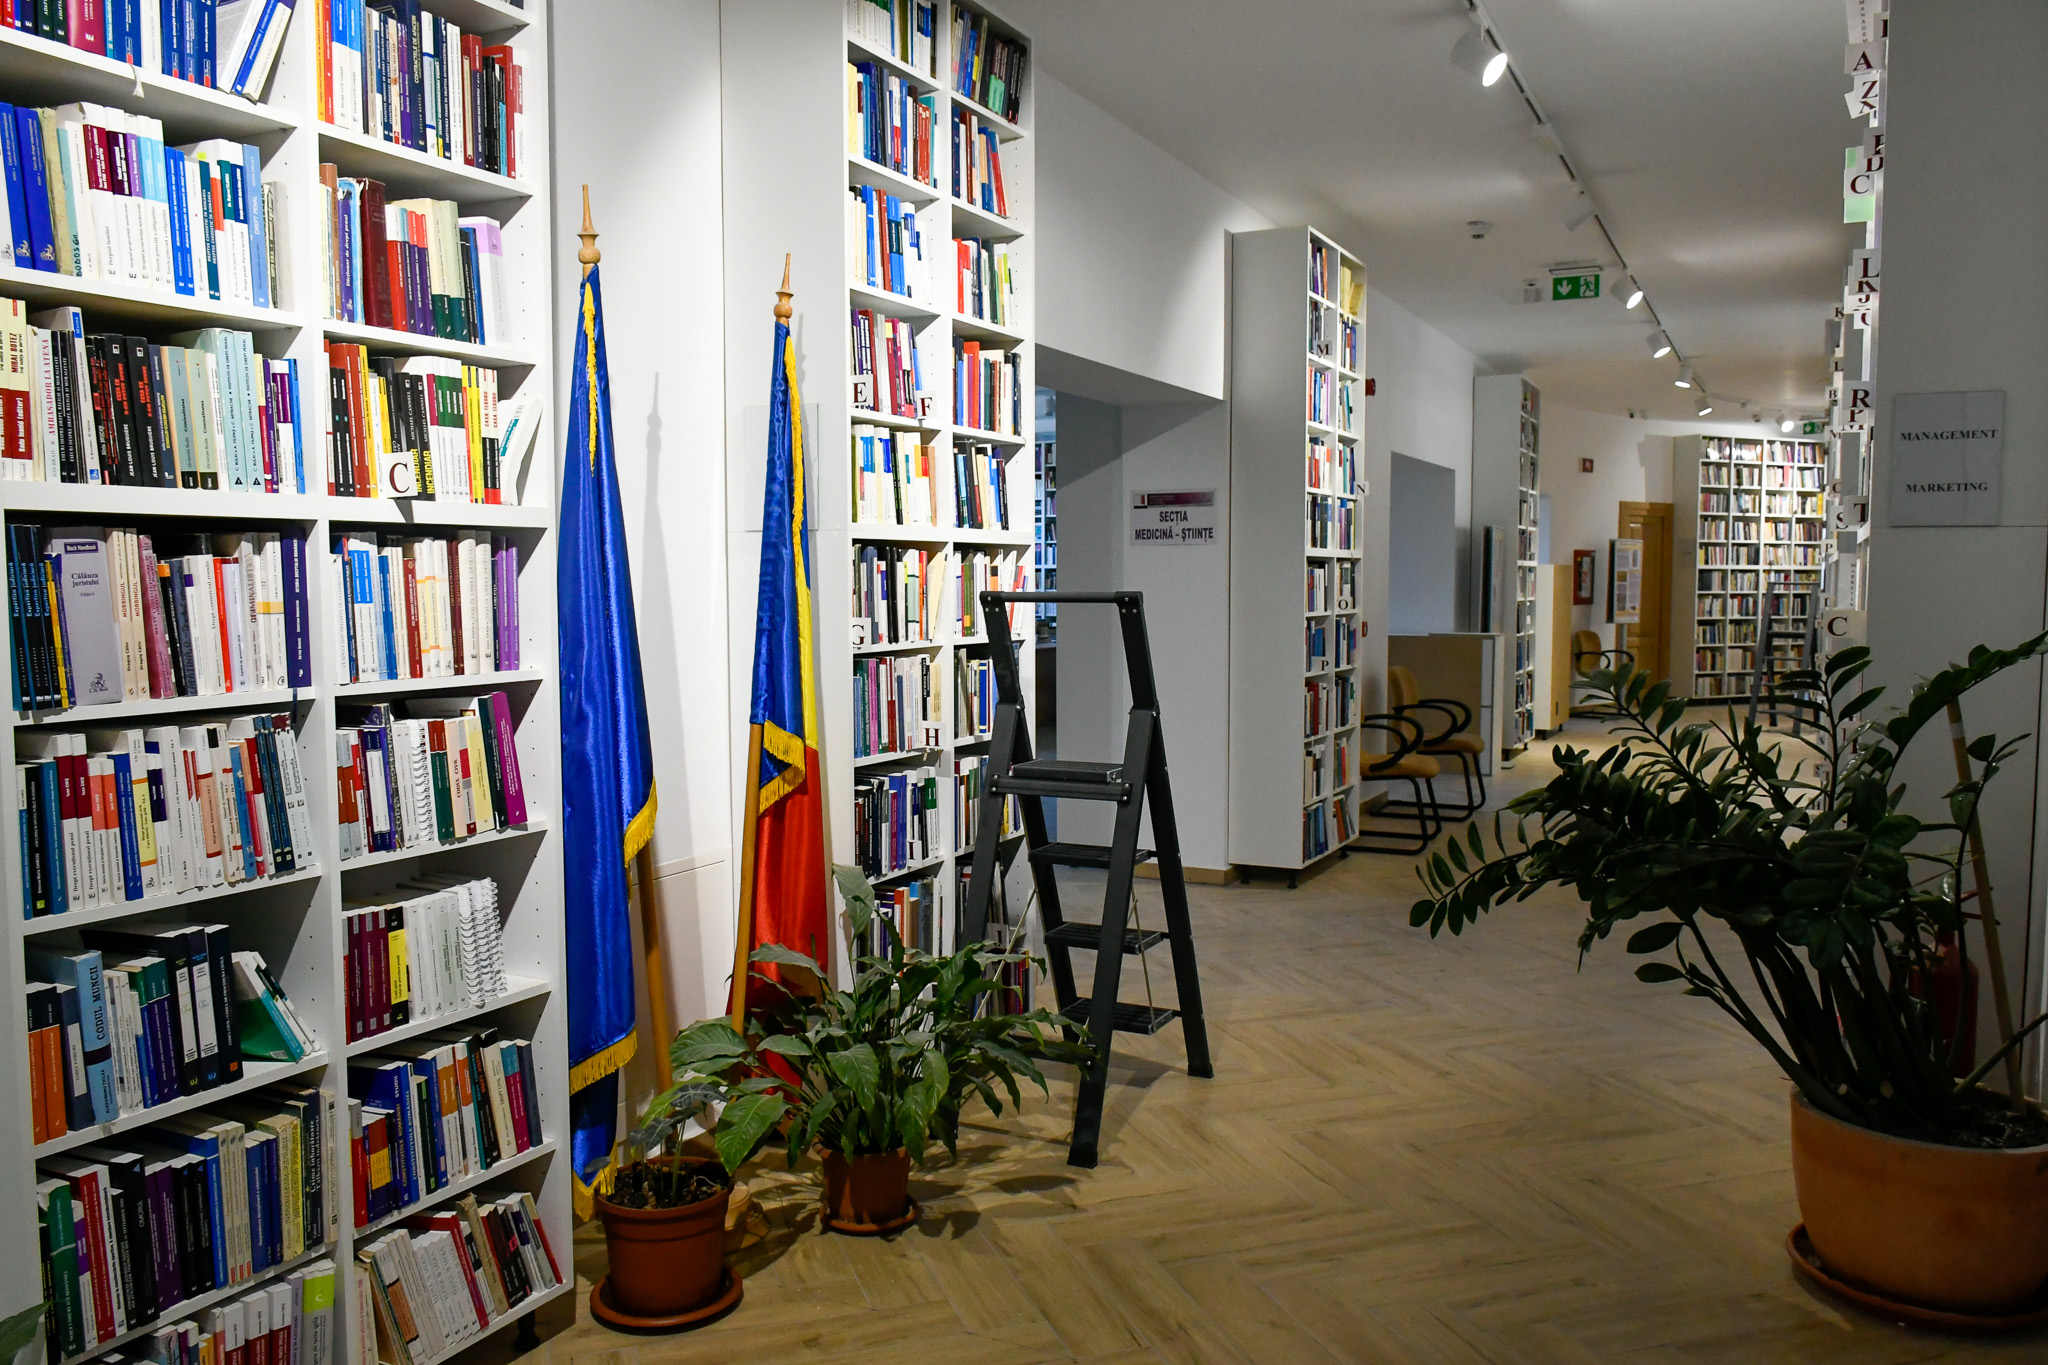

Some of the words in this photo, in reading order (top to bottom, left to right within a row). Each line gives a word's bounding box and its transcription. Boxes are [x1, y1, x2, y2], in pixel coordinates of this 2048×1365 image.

[1853, 50, 1873, 72] A
[1850, 174, 1870, 194] C
[1860, 257, 1880, 279] L
[42, 339, 50, 367] ATENA
[1316, 343, 1329, 355] M
[44, 370, 51, 380] LA
[853, 382, 867, 403] E
[1828, 390, 1837, 399] B
[1850, 388, 1871, 408] R
[45, 382, 56, 435] AMBASADOR
[919, 397, 932, 417] F
[1900, 429, 1998, 442] MANAGEMENT
[389, 463, 410, 493] C
[423, 450, 435, 494] INCENDIAR
[1356, 484, 1366, 495] N
[1905, 481, 1989, 493] MARKETING
[1134, 525, 1174, 540] MEDICINĂ
[1338, 599, 1348, 610] O
[852, 624, 864, 645] G
[1827, 616, 1848, 636] C
[1320, 660, 1329, 671] P
[924, 728, 940, 747] H
[89, 966, 101, 1002] MUNCII
[94, 1006, 106, 1040] CODUL
